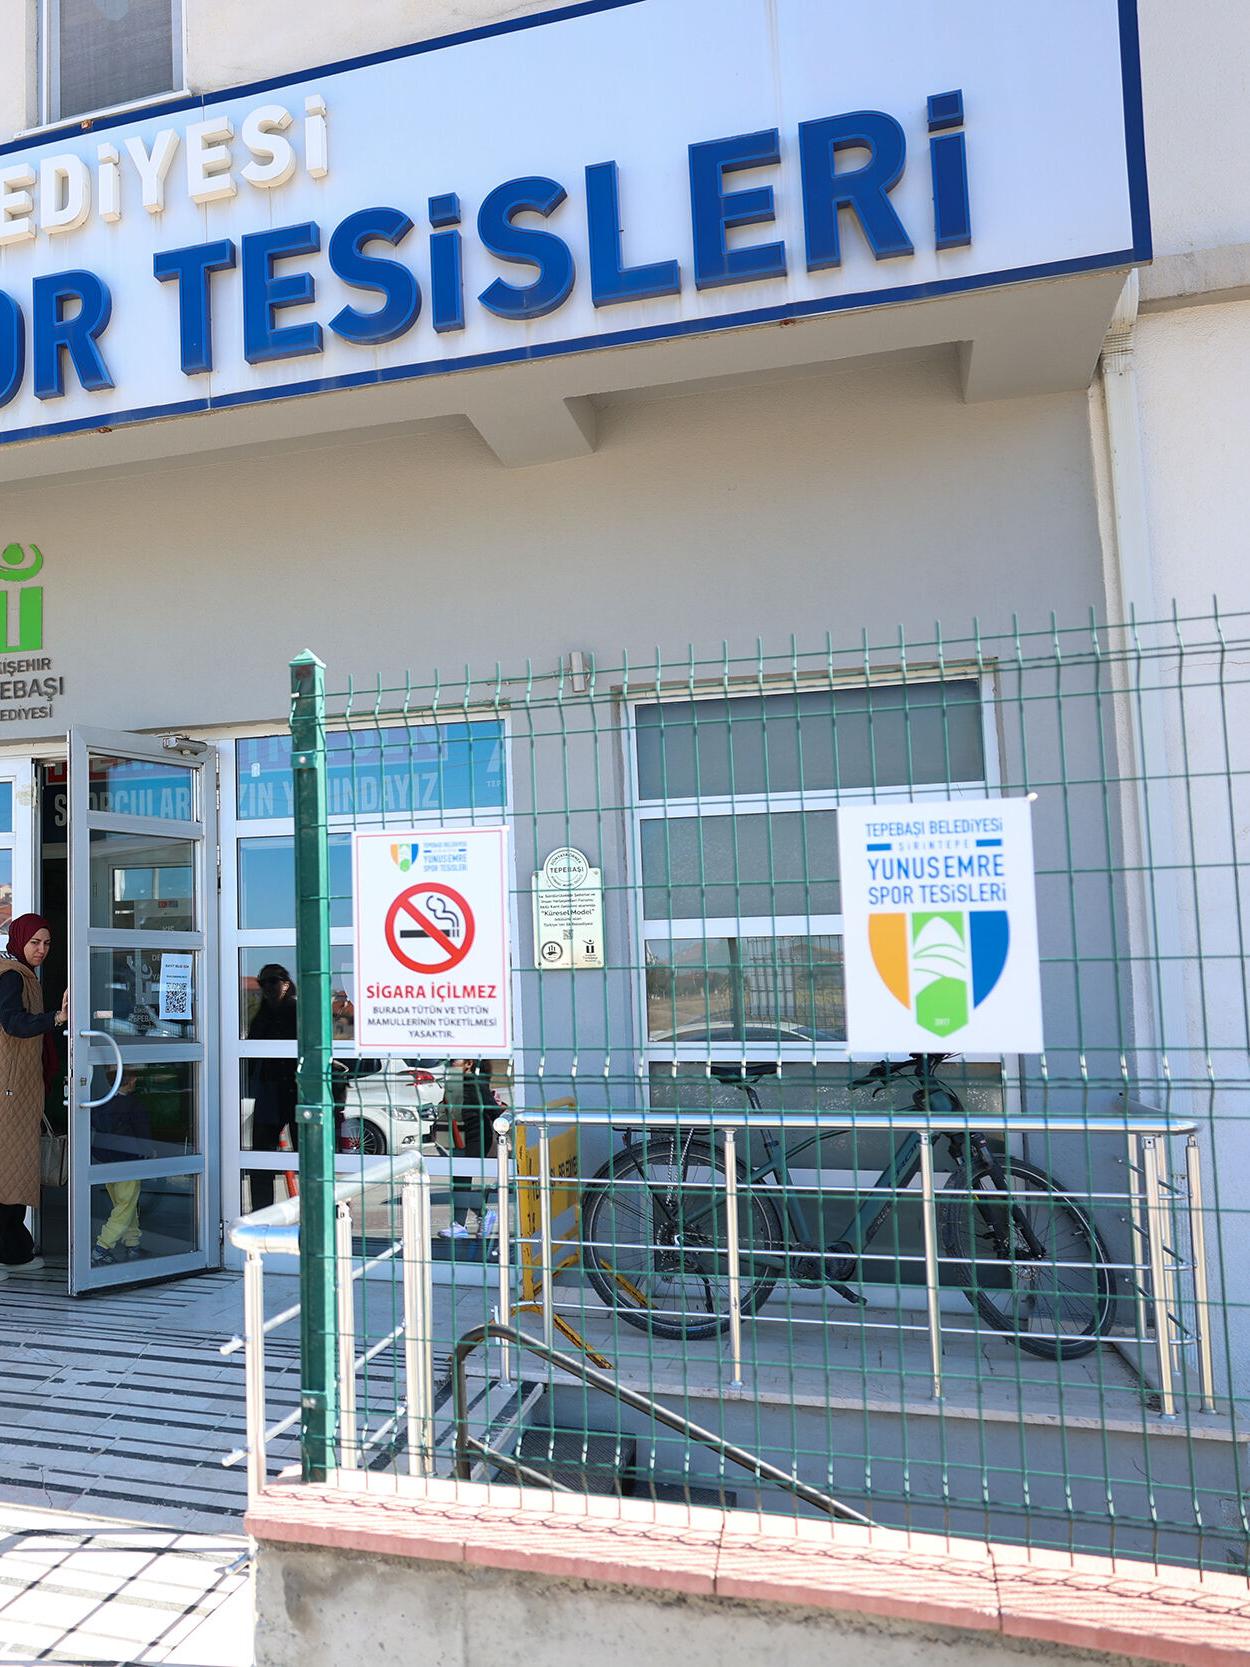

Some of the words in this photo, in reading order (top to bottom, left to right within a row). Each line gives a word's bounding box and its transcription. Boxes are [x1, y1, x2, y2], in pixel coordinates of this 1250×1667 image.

[153, 89, 972, 376] TESİSLERİ
[865, 821, 925, 837] TEPEBAŞI
[929, 817, 1003, 834] BELEDİYESİ
[868, 885, 914, 905] SPOR
[919, 882, 1007, 903] TESİSLERİ
[366, 981, 426, 999] SİGARA
[431, 981, 498, 1003] İÇİLMEZ
[373, 1006, 410, 1015] BURADA
[412, 1004, 443, 1015] TÜTÜN
[445, 1006, 456, 1015] VE
[458, 1004, 489, 1015] TÜTÜN
